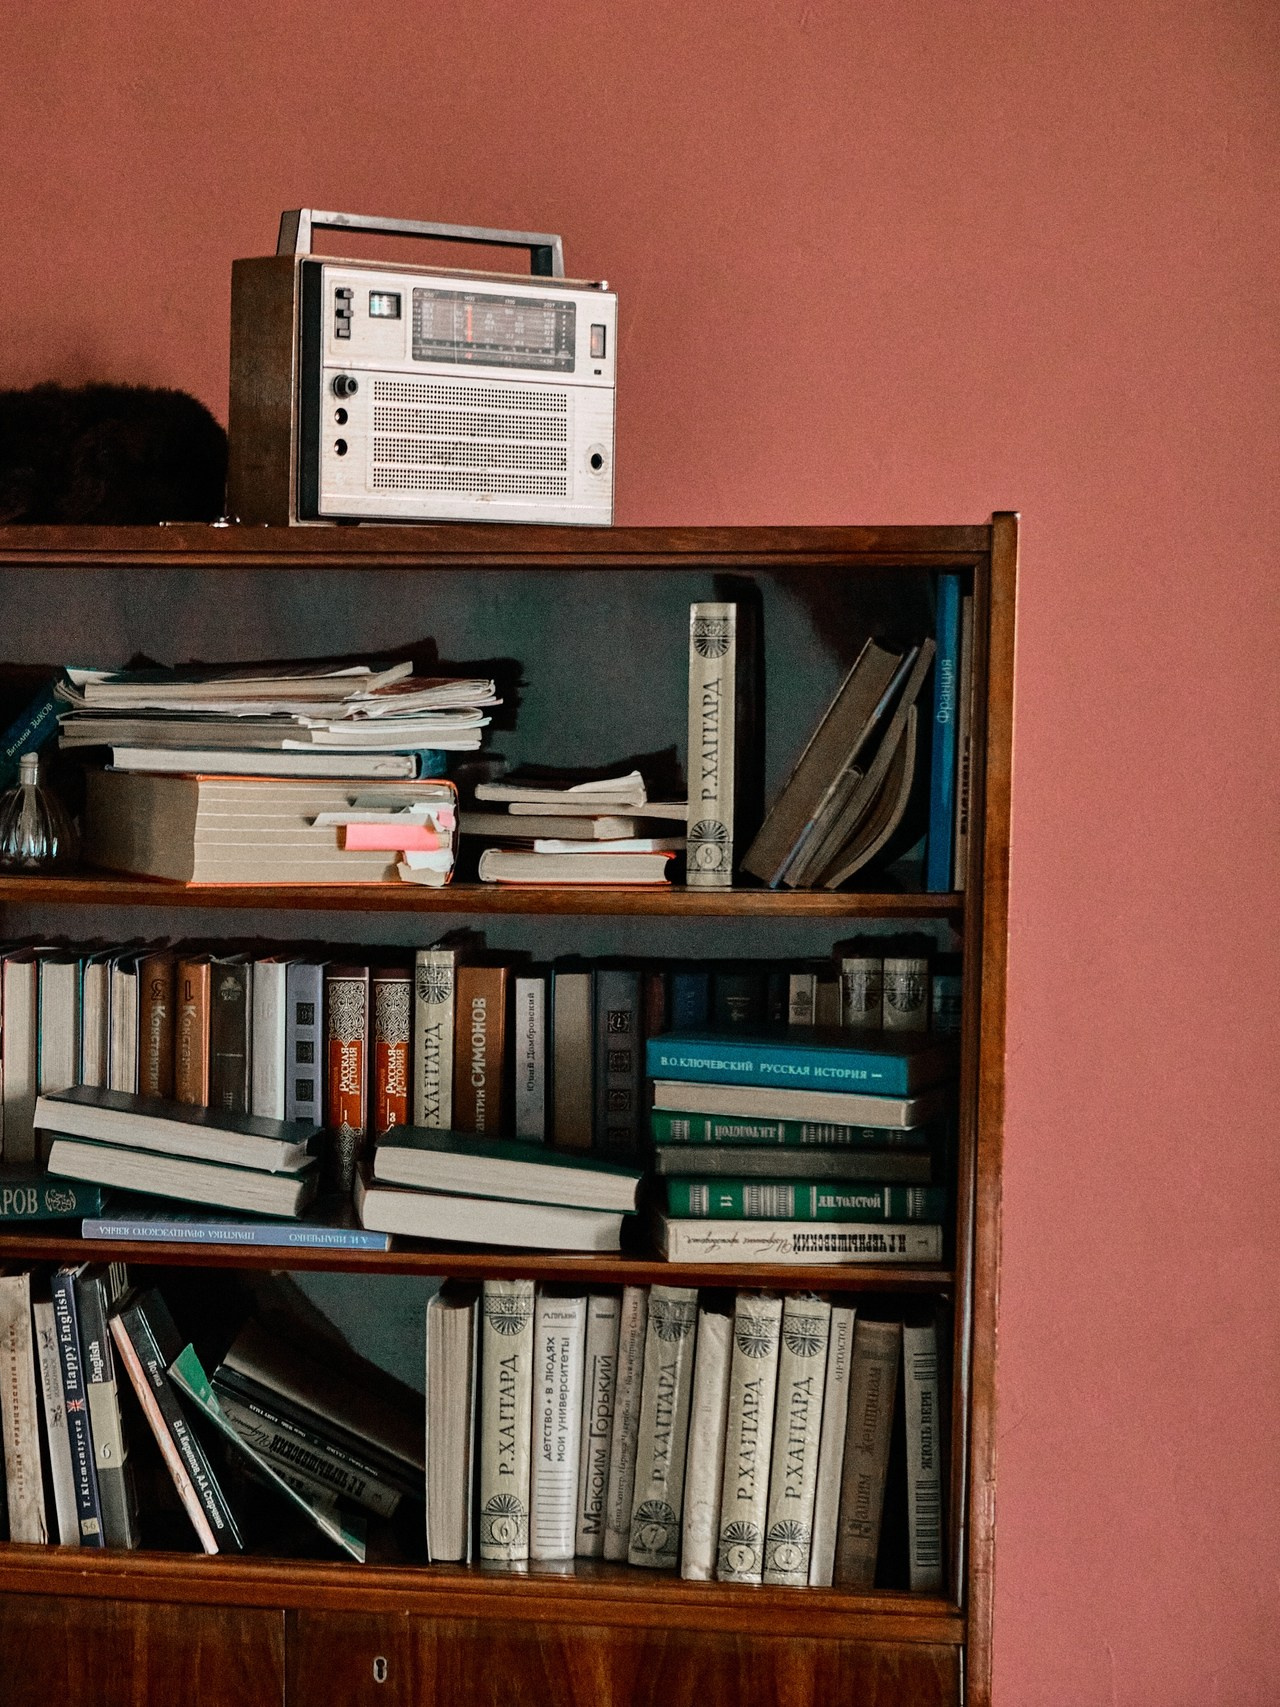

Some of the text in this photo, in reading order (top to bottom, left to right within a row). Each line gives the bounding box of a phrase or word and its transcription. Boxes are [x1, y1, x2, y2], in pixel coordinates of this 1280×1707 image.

[936, 659, 954, 724] Франция
[6, 702, 53, 757] Виталий ЗЫКОВ
[701, 677, 723, 802] Р.ХАГГАРД
[704, 847, 713, 863] 8
[149, 1005, 166, 1089] Константин
[526, 993, 536, 1060] Домбровский
[338, 1047, 350, 1092] РУССКАЯ
[348, 1047, 360, 1095] ИСТОРИЯ
[386, 1049, 398, 1094] РУССКАЯ
[395, 1049, 407, 1097] ИСТОРИЯ
[424, 1022, 443, 1125] .ХАГГАРД
[471, 997, 486, 1134] антин СИМОНОВ
[660, 1056, 754, 1072] В.О.КЛЮЧЕВСКИЙ
[760, 1062, 810, 1077] РУССКАЯ
[814, 1066, 868, 1079] ИСТОРИЯ
[720, 1194, 733, 1207] 11
[99, 1226, 255, 1241] ПРАКТИКА ФРАНЦУЗСКОГО ЯЗЫКА
[289, 1233, 346, 1244] ИВАНЧЕНКО
[54, 1288, 79, 1390] Happy English
[88, 1340, 104, 1383] English
[544, 1336, 556, 1382] людях
[147, 1360, 164, 1388] Логика
[556, 1336, 571, 1463] мои университеты
[499, 1354, 519, 1476] Р.ХАГГАРД
[542, 1407, 553, 1463] детство
[737, 1377, 763, 1502] Р.ХАГГАРД
[784, 1375, 814, 1501] Р.ХАГГАРД
[859, 1365, 882, 1458] женщинам
[920, 1389, 933, 1470] ЖЮЛЬ ВЕРН
[74, 1420, 91, 1507] T.Klementyeva
[100, 1442, 111, 1459] 6
[583, 1354, 614, 1535] Максим Горький
[179, 1435, 203, 1479] Кириллов,
[203, 1489, 225, 1531] Старченко
[650, 1529, 658, 1544] 7
